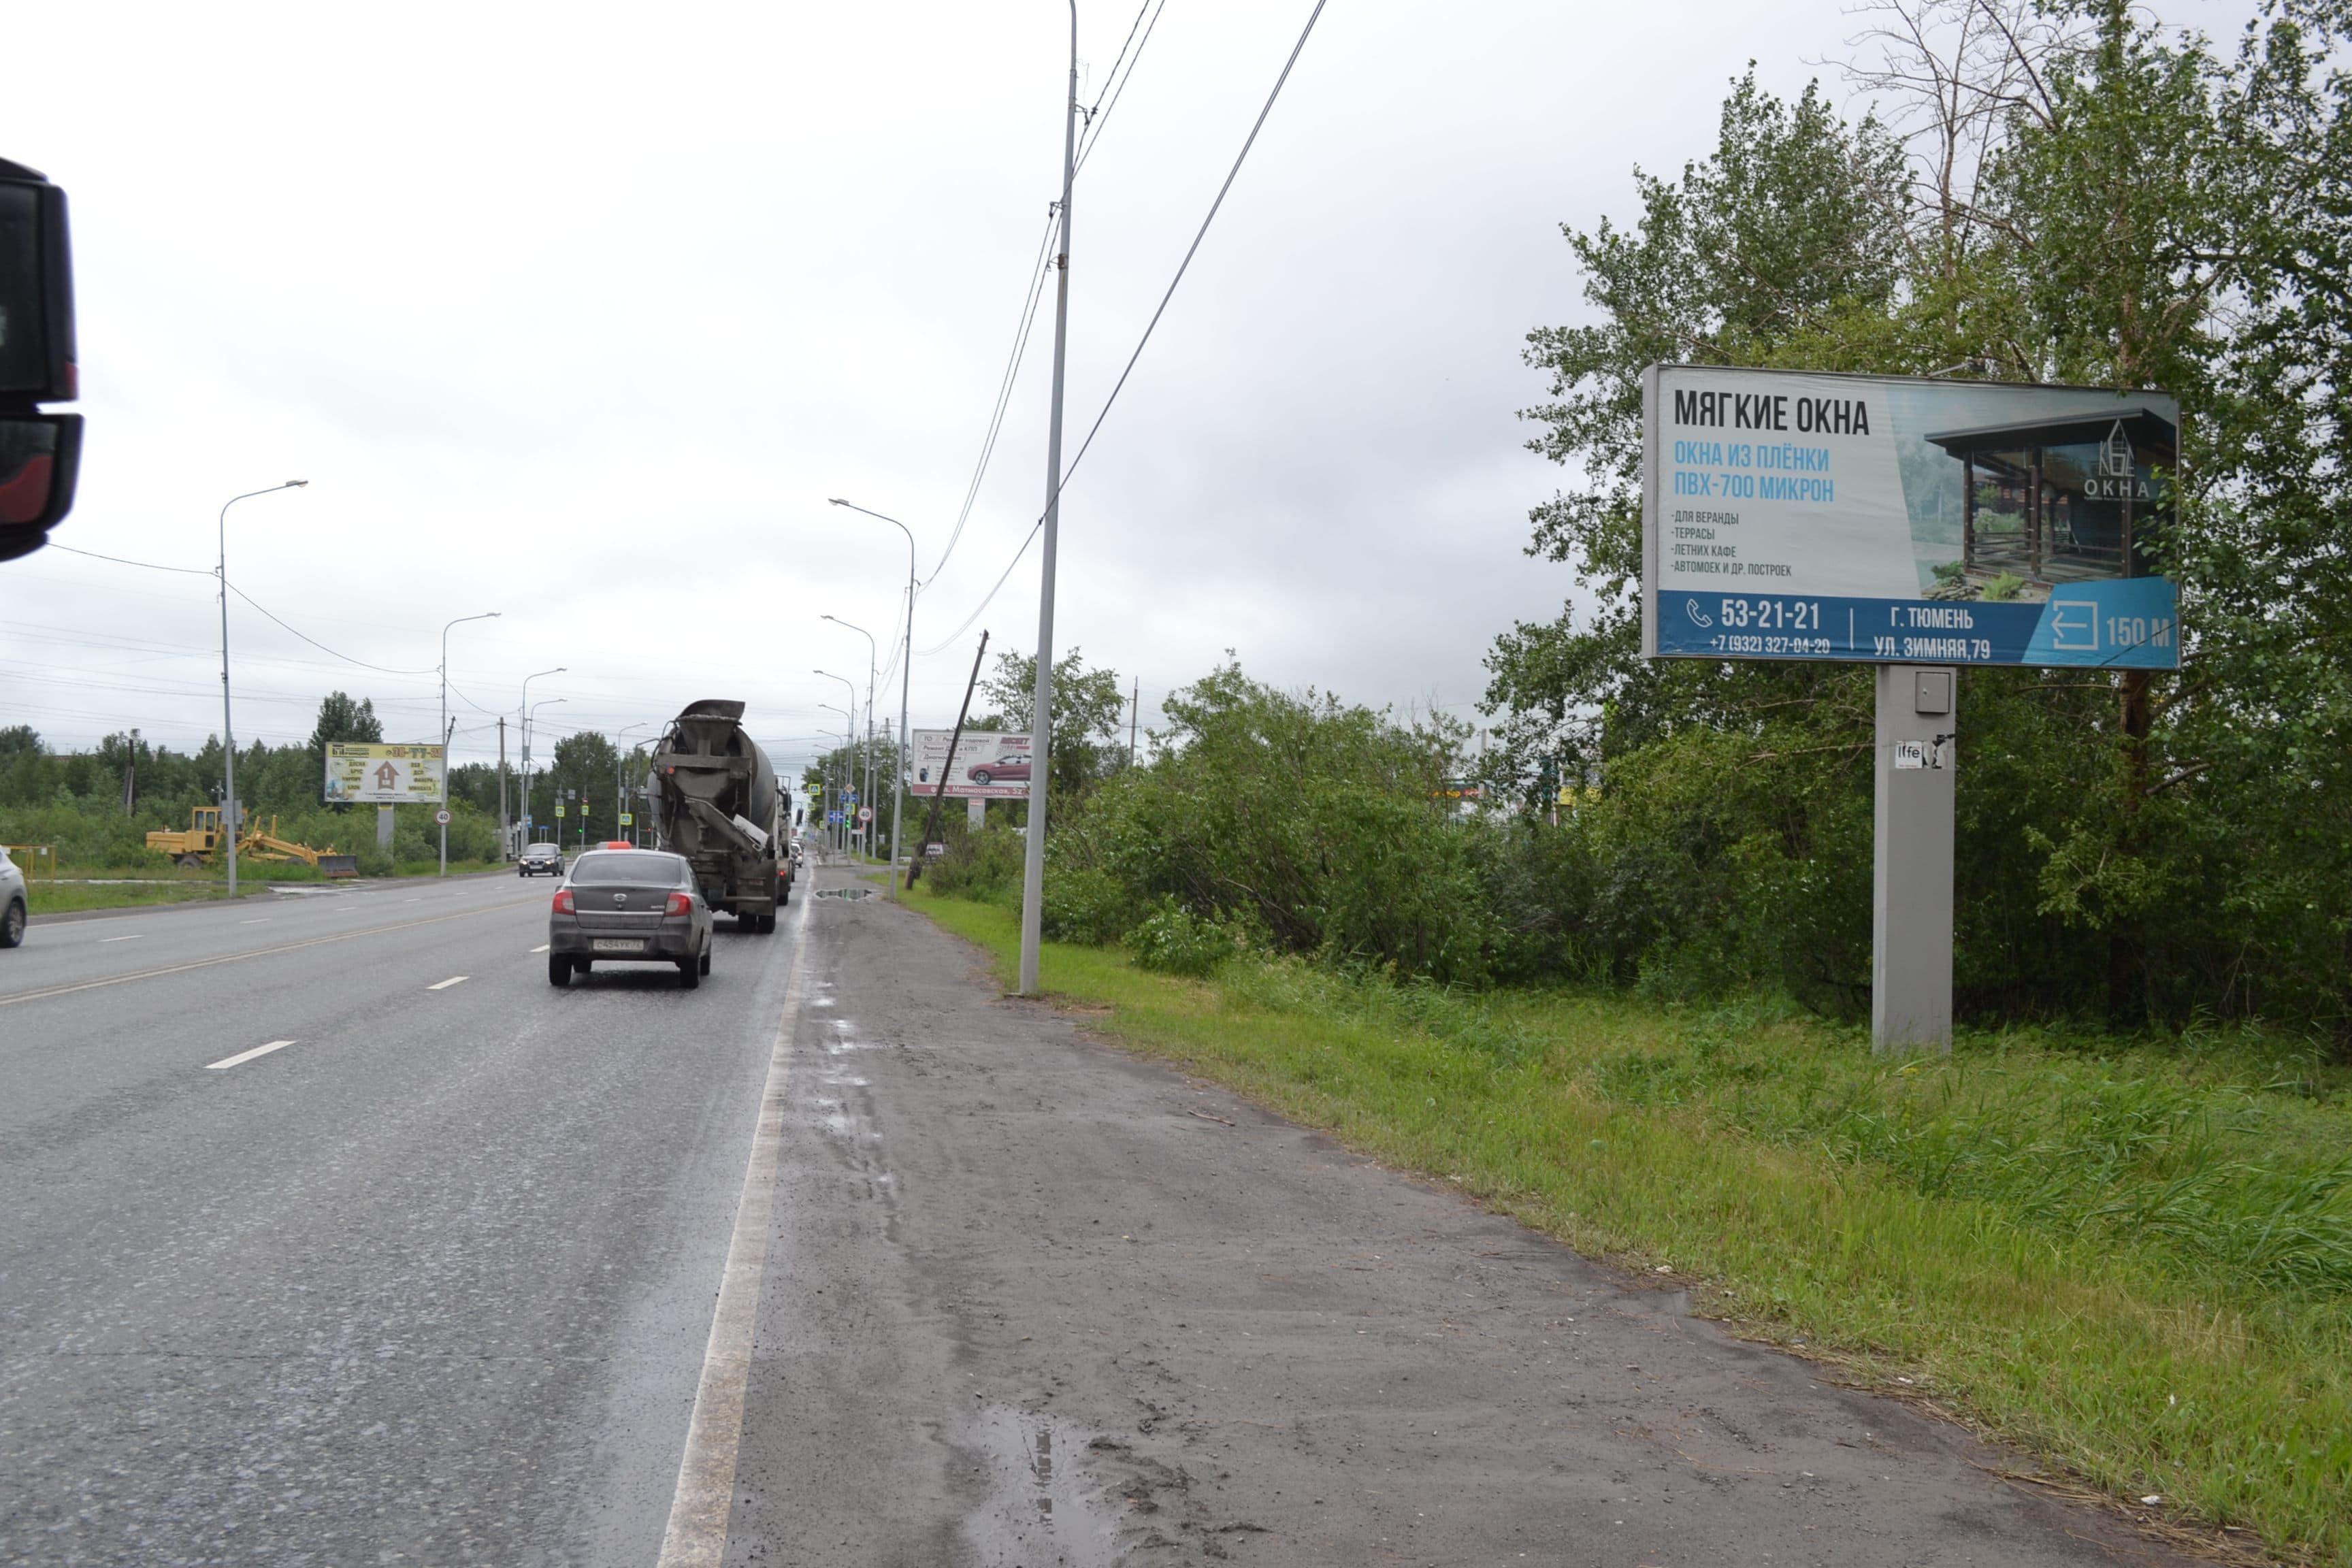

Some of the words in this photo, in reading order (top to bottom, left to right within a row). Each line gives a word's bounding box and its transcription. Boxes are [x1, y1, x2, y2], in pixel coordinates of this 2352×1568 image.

[1675, 389, 1788, 431] МЯГКИЕ
[1797, 397, 1869, 436] ОКНА
[1675, 440, 1722, 466] ОКНА
[1728, 444, 1752, 468] ИЗ
[1757, 443, 1829, 472] ПЛЁНКИ
[1675, 472, 1754, 498] ПВХ-700
[1759, 476, 1834, 502] МИКРОН
[2084, 478, 2150, 498] ОКНА
[1696, 512, 1740, 525] ВЕРАНДЫ
[1712, 545, 1736, 558] КАФЕ
[1722, 563, 1729, 574] И
[1731, 564, 1747, 576] ДР.
[1748, 564, 1792, 576] ПОСТРОЕК
[1722, 599, 1818, 630] 53-21-21
[1891, 607, 1904, 627] Г.
[1908, 607, 1974, 630] ТЮМЕНЬ
[2107, 617, 2146, 646] 150
[2152, 619, 2170, 647] М
[1710, 635, 1726, 650] +7
[1729, 635, 1762, 653] (932)
[1765, 636, 1830, 654] 327-04-20
[1874, 636, 1899, 659] УЛ.
[1904, 636, 1991, 661] ЗИМНЯЯ,79
[383, 768, 389, 779] 1
